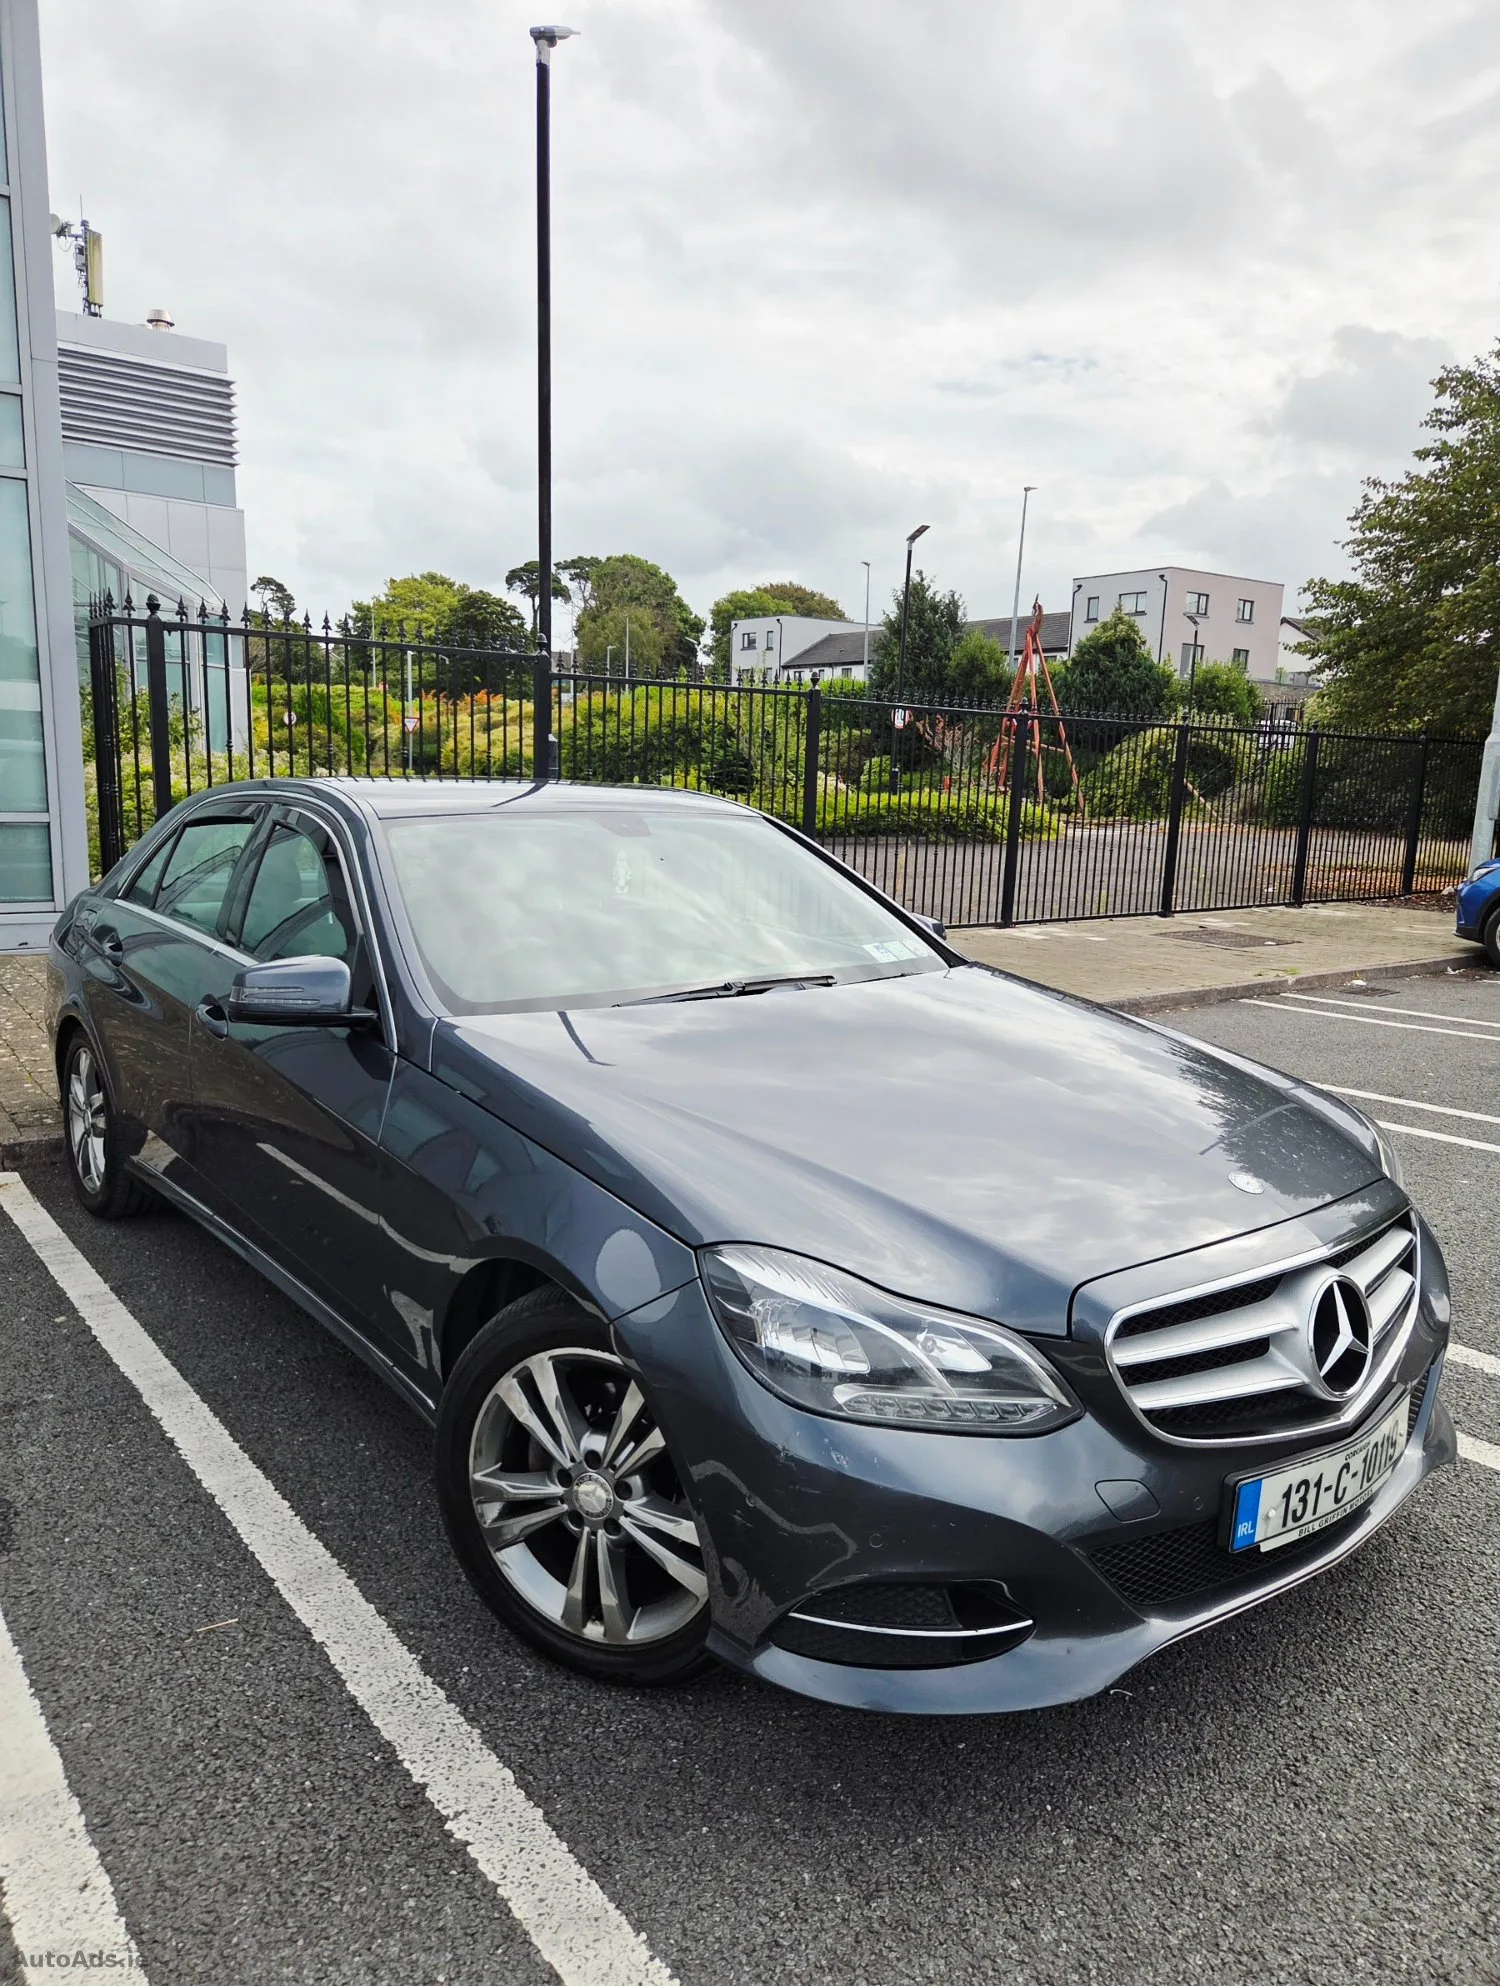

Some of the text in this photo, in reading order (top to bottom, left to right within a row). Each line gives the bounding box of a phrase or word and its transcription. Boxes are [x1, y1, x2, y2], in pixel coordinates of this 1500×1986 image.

[1237, 1419, 1400, 1538] IRL 131-C-10119
[1298, 1487, 1374, 1537] BILL GRIFFIN MOTORS
